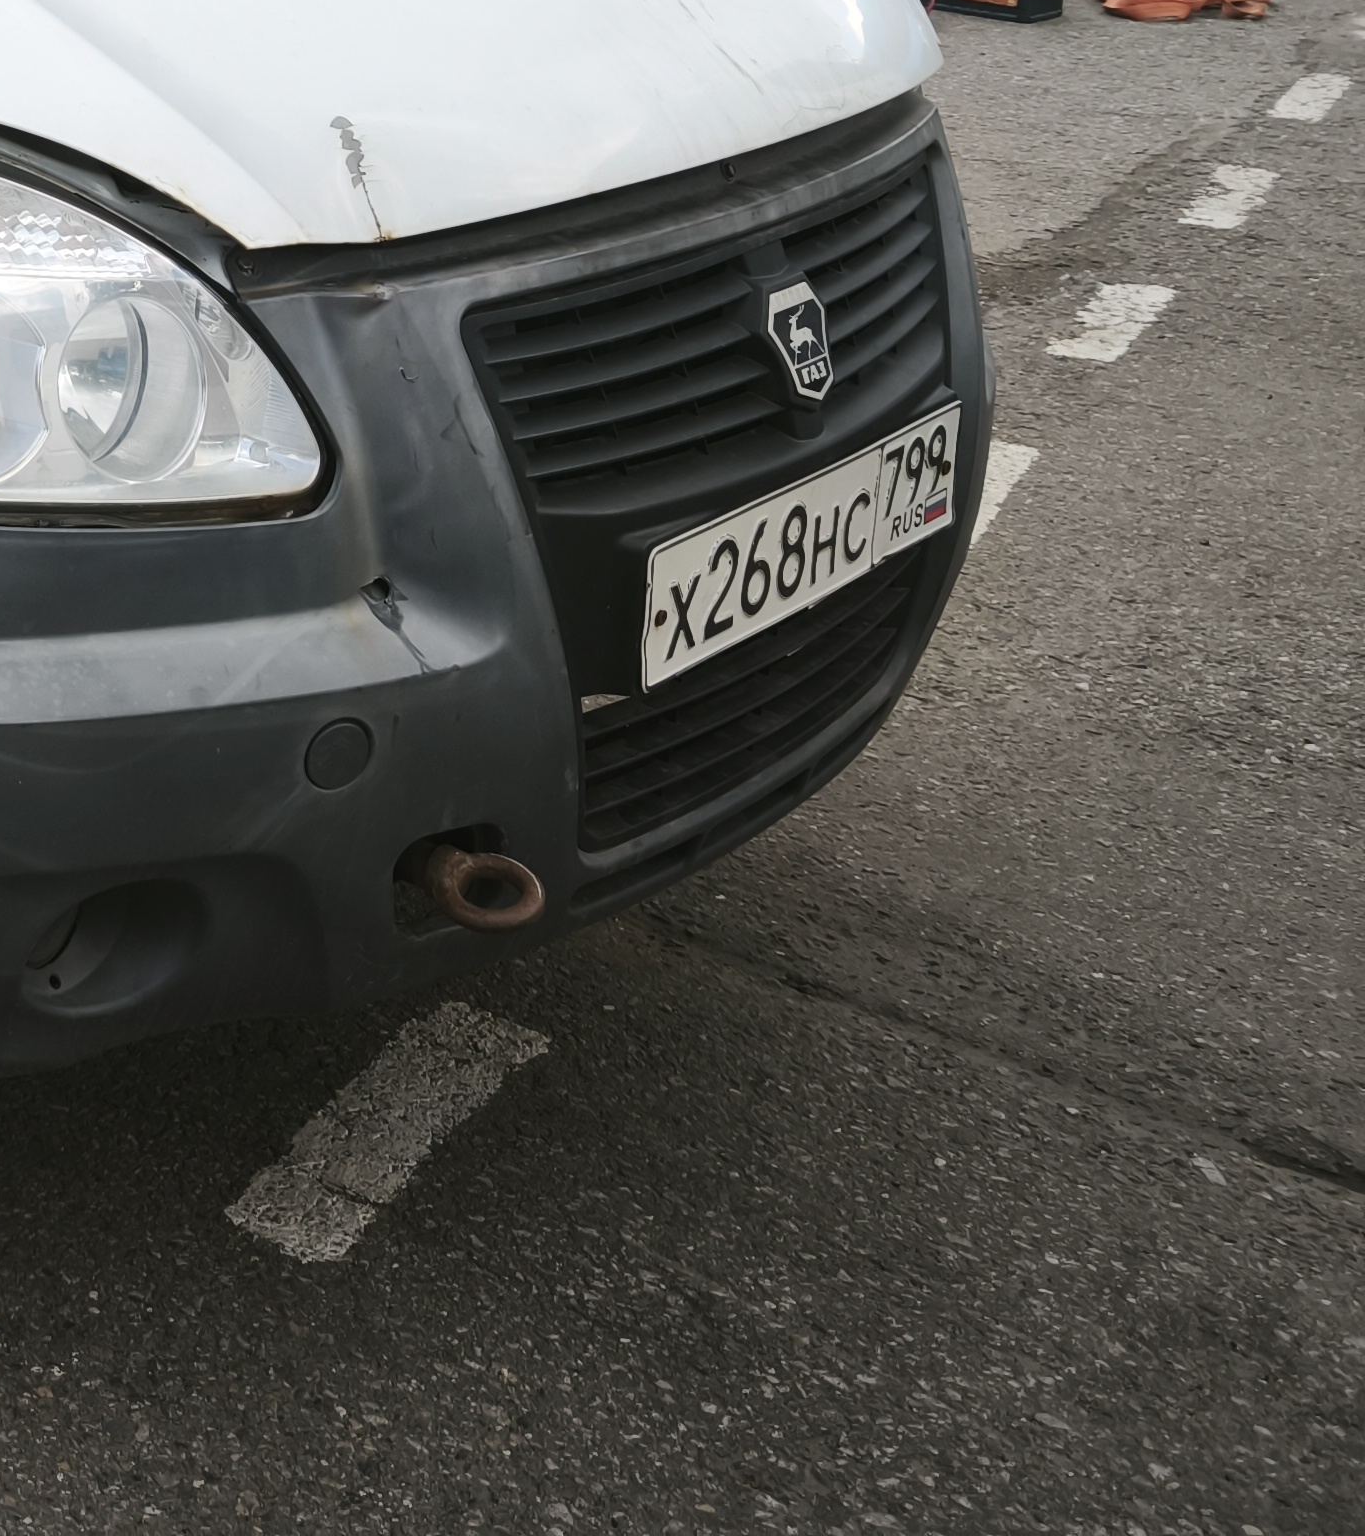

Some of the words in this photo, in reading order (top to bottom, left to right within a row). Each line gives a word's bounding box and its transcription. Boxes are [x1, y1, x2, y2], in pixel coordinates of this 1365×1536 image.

[801, 361, 827, 384] ГАЗ
[882, 424, 948, 520] 799
[889, 503, 925, 542] RUS
